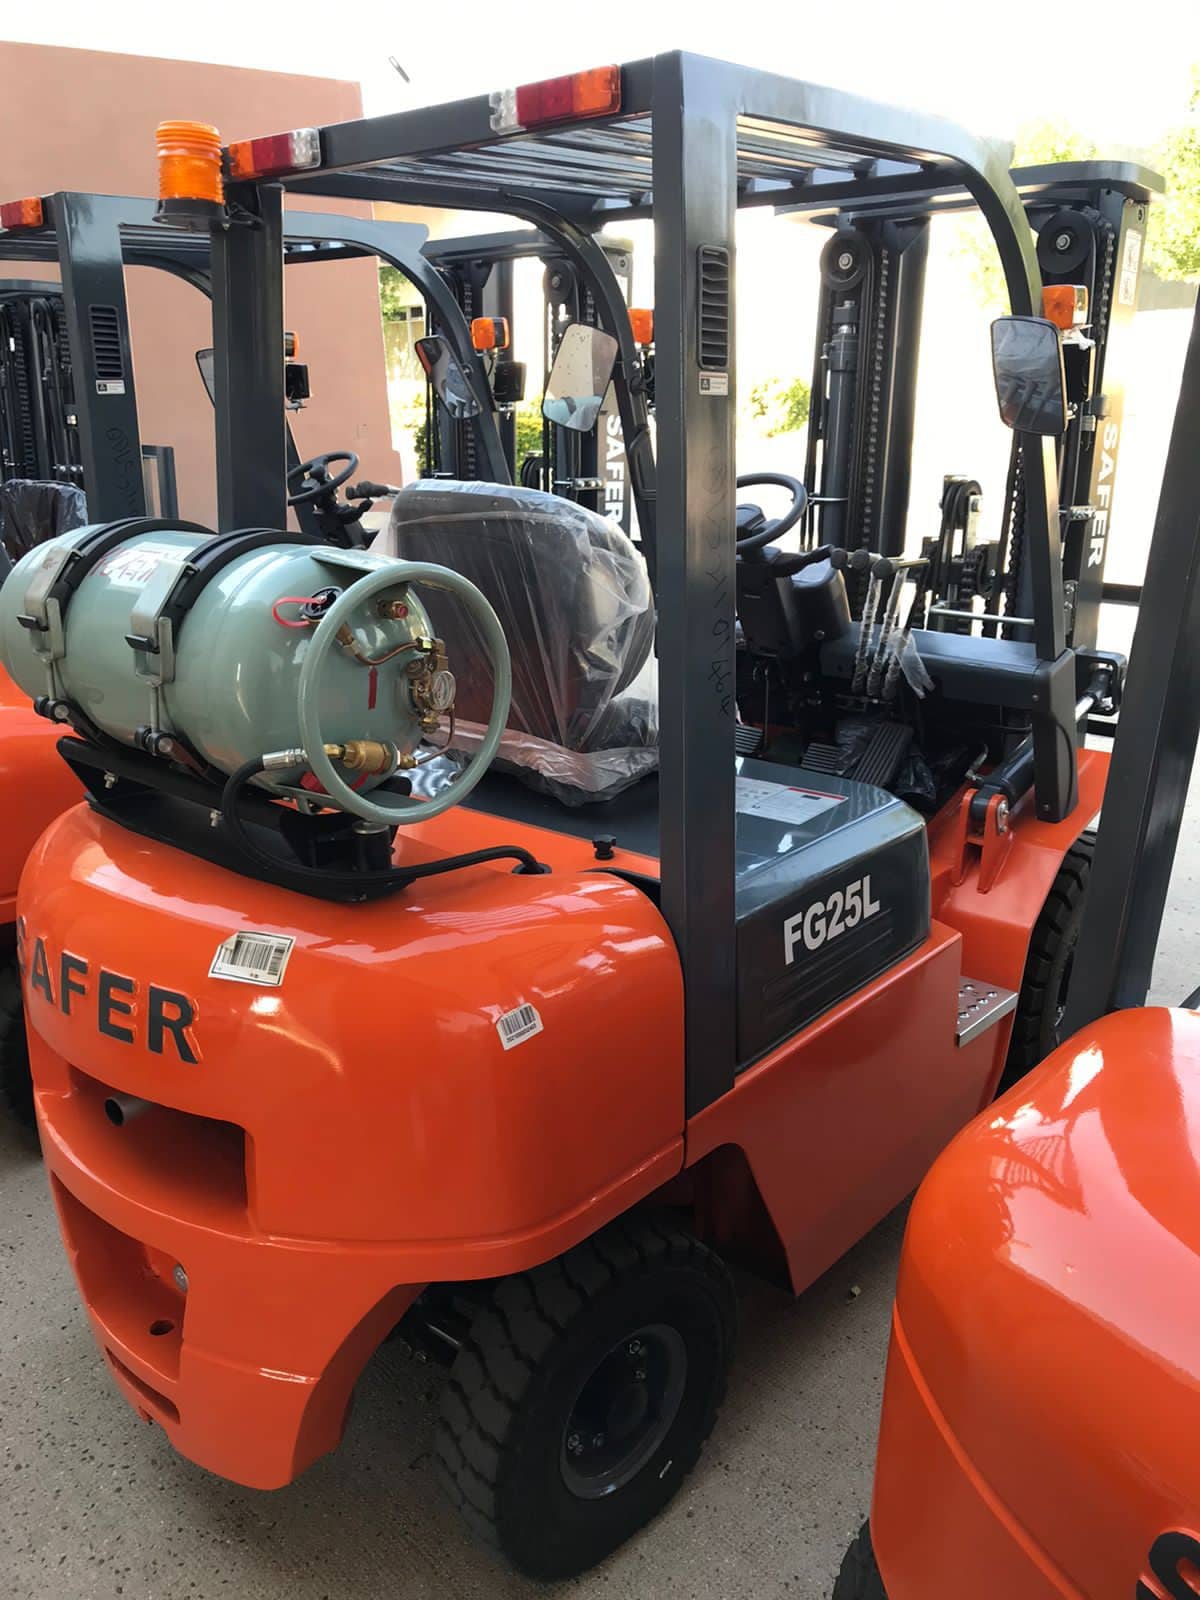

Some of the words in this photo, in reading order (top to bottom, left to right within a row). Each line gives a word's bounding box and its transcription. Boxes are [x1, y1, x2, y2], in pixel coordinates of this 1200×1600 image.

[605, 414, 625, 524] SAFER
[1088, 422, 1118, 568] SAFER
[784, 874, 880, 966] FG25L
